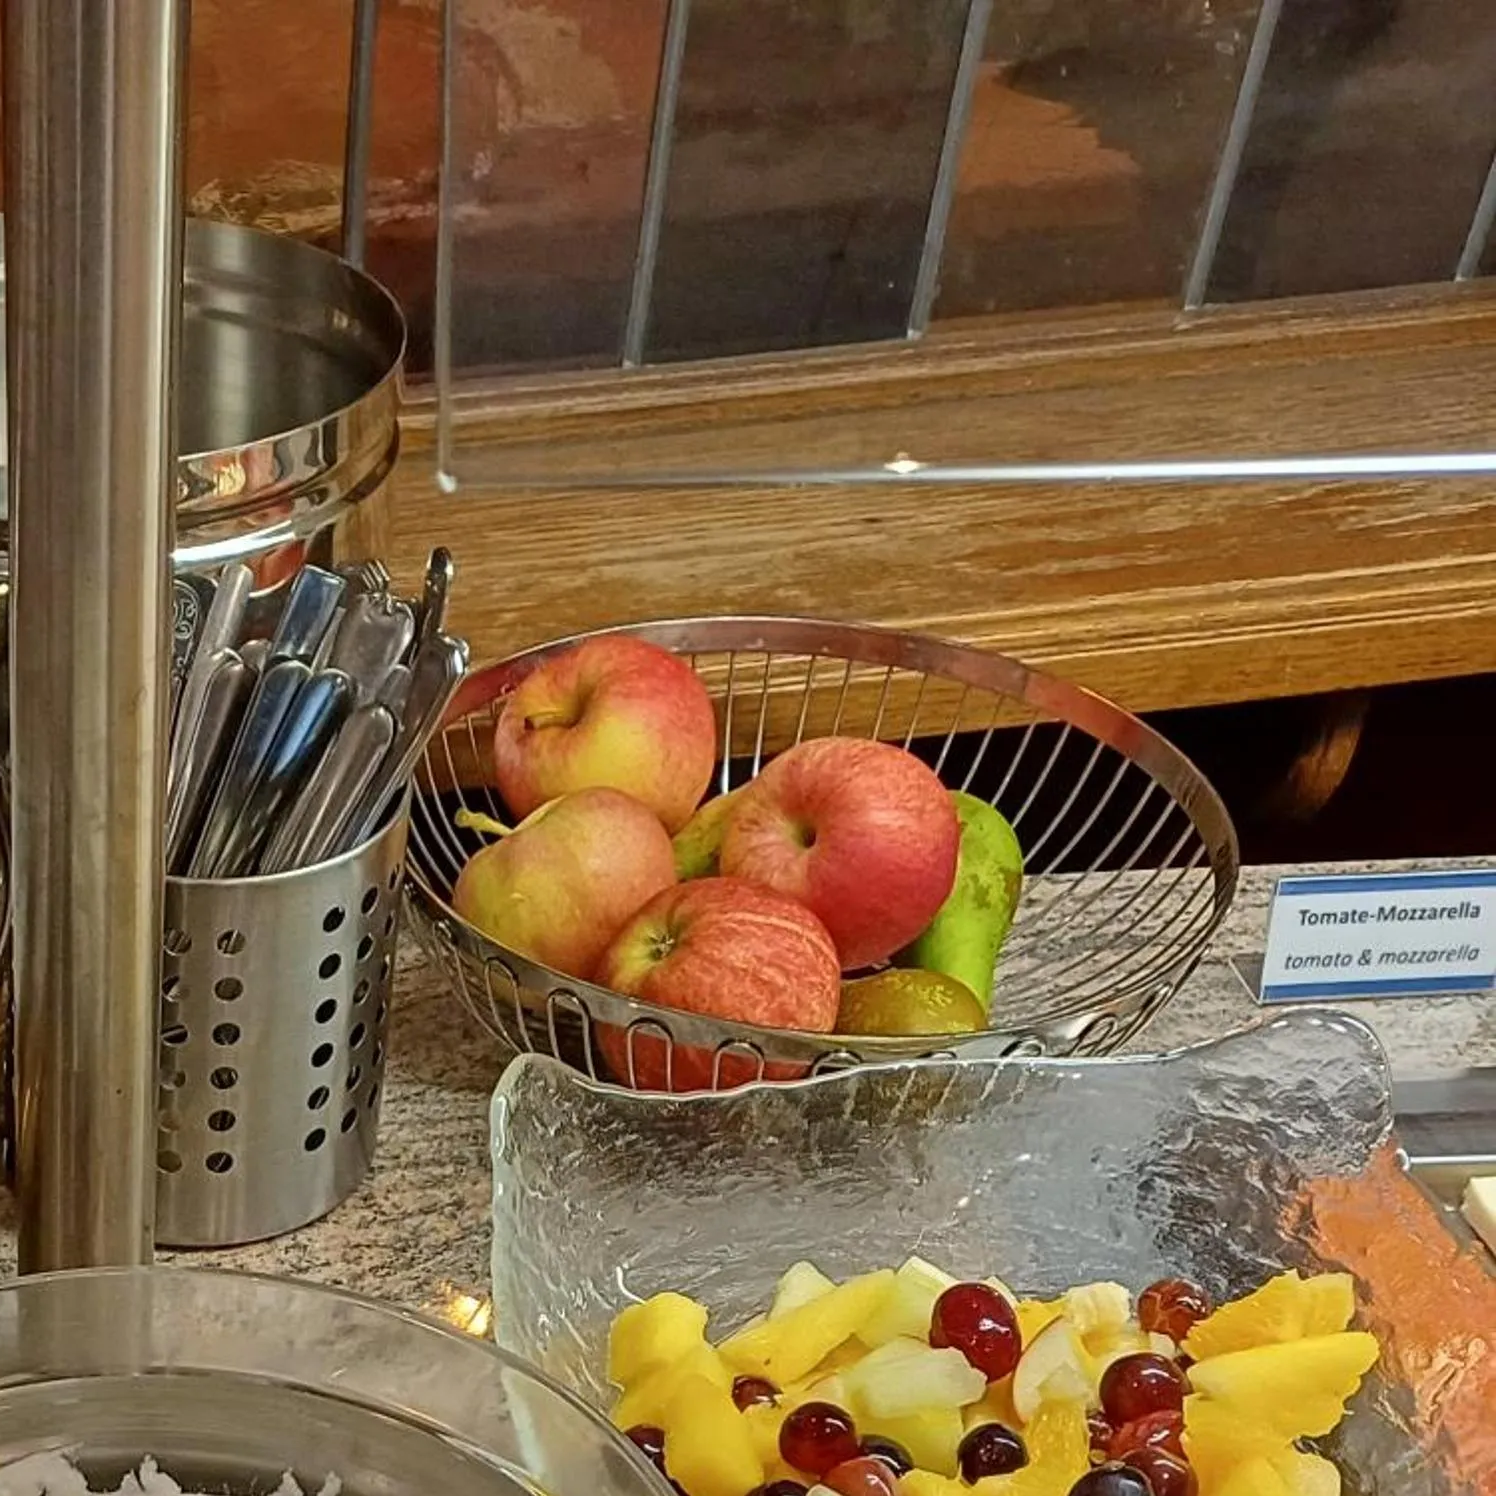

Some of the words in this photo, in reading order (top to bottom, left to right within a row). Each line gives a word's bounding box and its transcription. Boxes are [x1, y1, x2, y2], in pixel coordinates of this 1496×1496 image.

[1299, 902, 1481, 926] Tomate-Mozzarella
[1284, 953, 1353, 970] tomato
[1358, 949, 1372, 966] &
[1378, 944, 1480, 965] mozzarella
